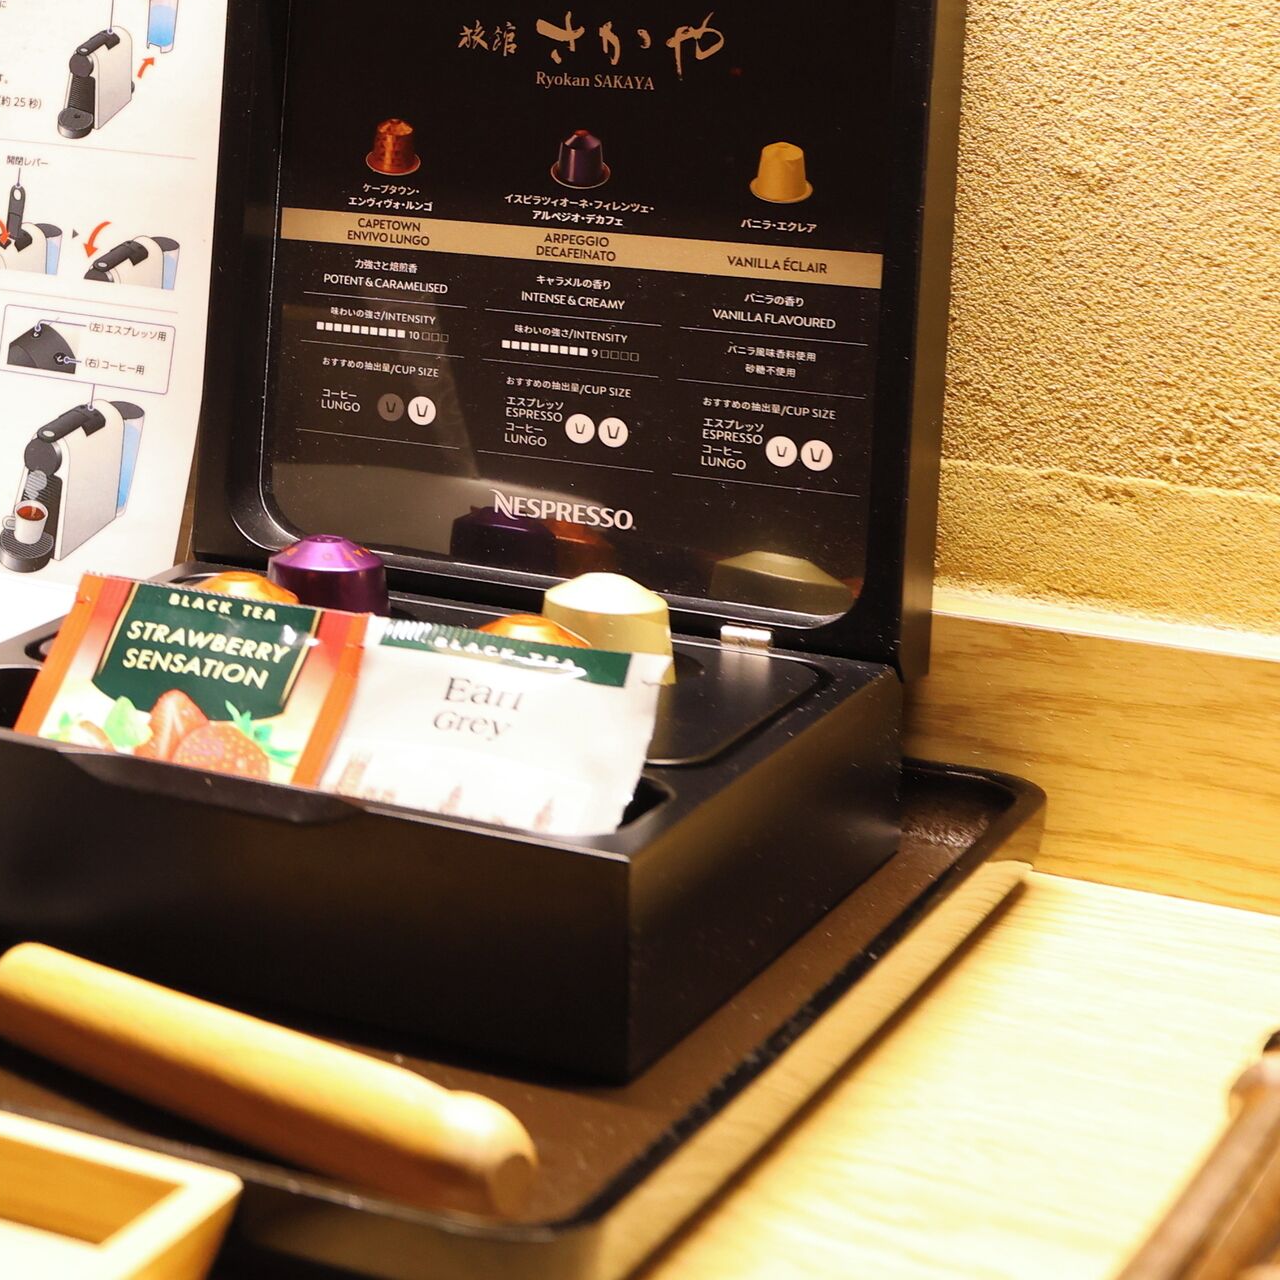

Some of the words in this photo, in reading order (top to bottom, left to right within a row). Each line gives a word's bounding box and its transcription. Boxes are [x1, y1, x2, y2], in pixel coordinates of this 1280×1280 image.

[536, 11, 725, 81] さかや
[536, 71, 590, 89] Ryokan
[594, 74, 655, 91] SAKAYA
[357, 217, 421, 232] CAPETOWN
[740, 218, 817, 234] バニラ・エクレア
[347, 230, 388, 244] ENVIVO
[389, 233, 430, 247] LUNGO
[544, 233, 610, 248] ARPEGGIO
[536, 245, 616, 262] DECAFEINATO
[727, 255, 781, 271] VANILLA
[783, 257, 827, 274] ÉCLAIR
[324, 273, 364, 287] POTENT
[365, 278, 374, 288] &
[374, 278, 449, 294] CARAMELISED
[536, 274, 612, 291] キャラメルの香り
[521, 291, 566, 305] INTENSE
[567, 296, 577, 306] &
[578, 297, 625, 310] CREAMY
[744, 292, 804, 308] バニラの香り
[712, 308, 763, 323] VANILLA
[764, 313, 836, 329] FLAVOURED
[409, 330, 420, 340] 10
[591, 348, 599, 358] 9
[418, 367, 440, 378] SIZE
[322, 388, 357, 400] コーヒー
[609, 387, 632, 399] SIZE
[321, 399, 361, 413] LUNGO
[506, 396, 564, 410] エスプレッソ
[505, 407, 563, 423] ESPRESSO
[812, 408, 837, 420] SIZE
[506, 422, 544, 434] コーヒー
[703, 418, 765, 432] エスプレッソ
[504, 433, 547, 447] LUNGO
[702, 429, 763, 445] ESPRESSO
[702, 444, 742, 456] コーヒー
[701, 456, 747, 470] LUNGO
[490, 489, 634, 530] NESPRESSO
[168, 592, 233, 615] BLACK
[242, 604, 277, 622] TEA
[126, 620, 291, 664] STRAWBERRY
[122, 647, 269, 690] SENSATION
[443, 675, 526, 711] Earl
[432, 709, 513, 741] Grey
